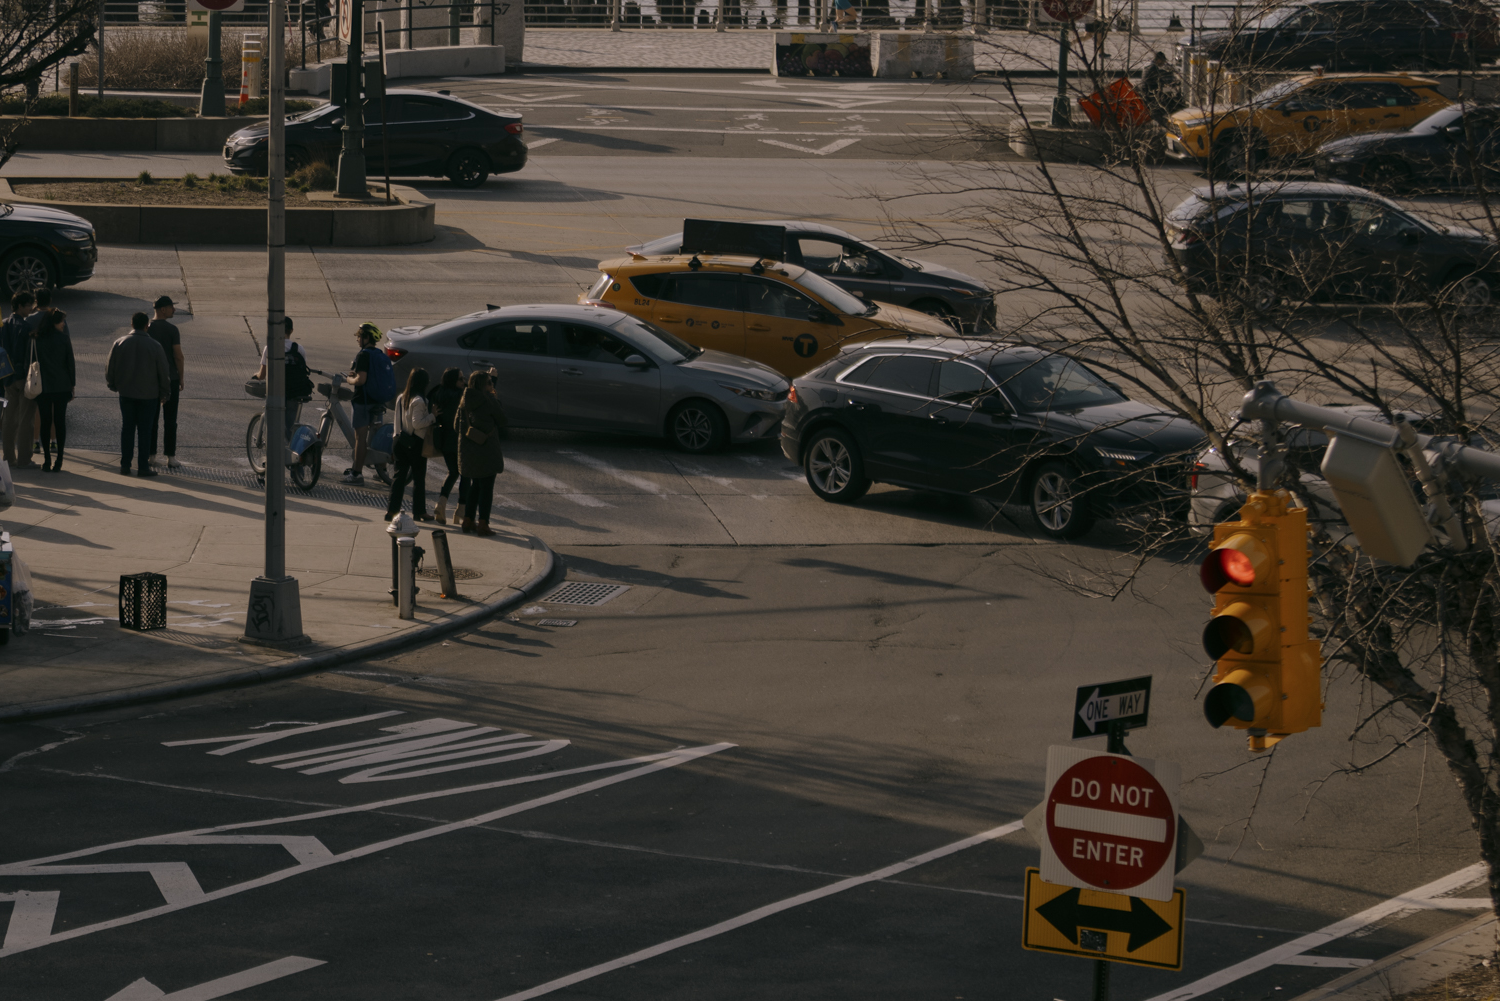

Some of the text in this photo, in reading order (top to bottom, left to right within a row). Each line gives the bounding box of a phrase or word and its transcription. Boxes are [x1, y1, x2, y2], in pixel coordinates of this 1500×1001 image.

[494, 3, 511, 16] 57
[1050, 1, 1083, 13] ENER
[799, 337, 814, 356] T
[1086, 693, 1142, 722] ONE WAY
[1070, 777, 1155, 809] DO NOT
[1071, 838, 1145, 868] ENTER
